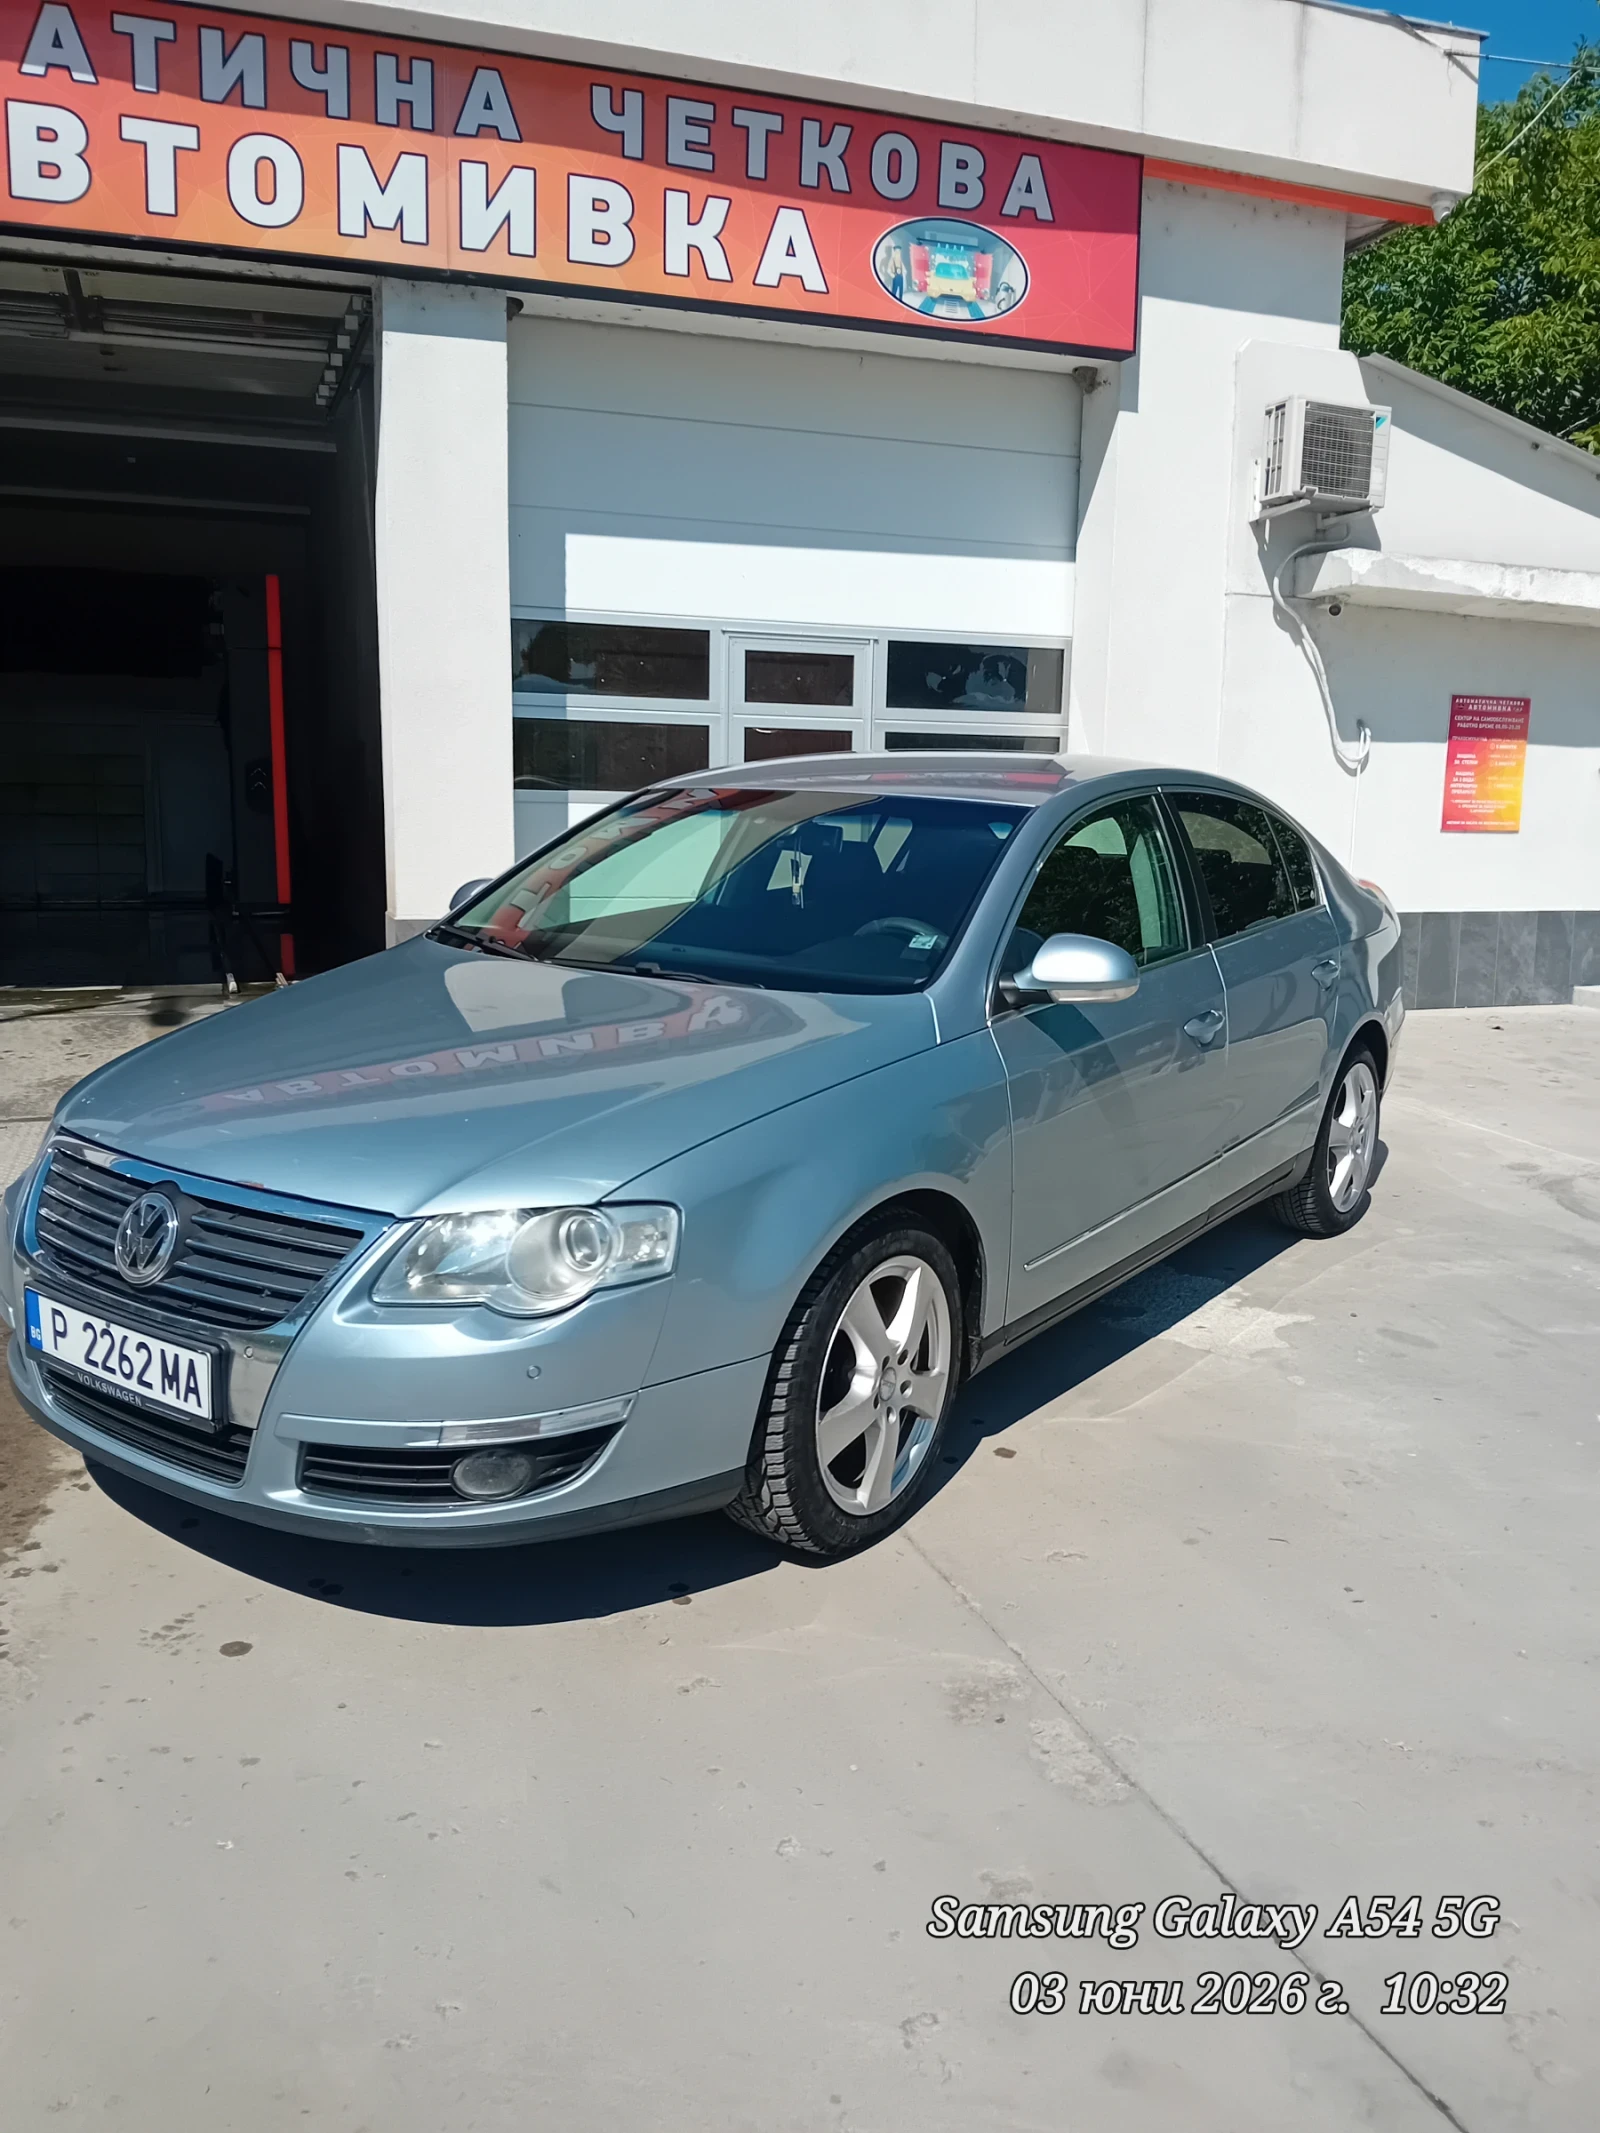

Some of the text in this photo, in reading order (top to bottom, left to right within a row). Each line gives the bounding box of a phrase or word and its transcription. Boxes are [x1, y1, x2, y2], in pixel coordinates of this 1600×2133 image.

[590, 83, 1055, 223] ЧЕТКОВА
[1468, 704, 1512, 712] АВТОМИВКА
[30, 1325, 42, 1341] BG
[76, 1371, 143, 1407] VOLKSWAGEN
